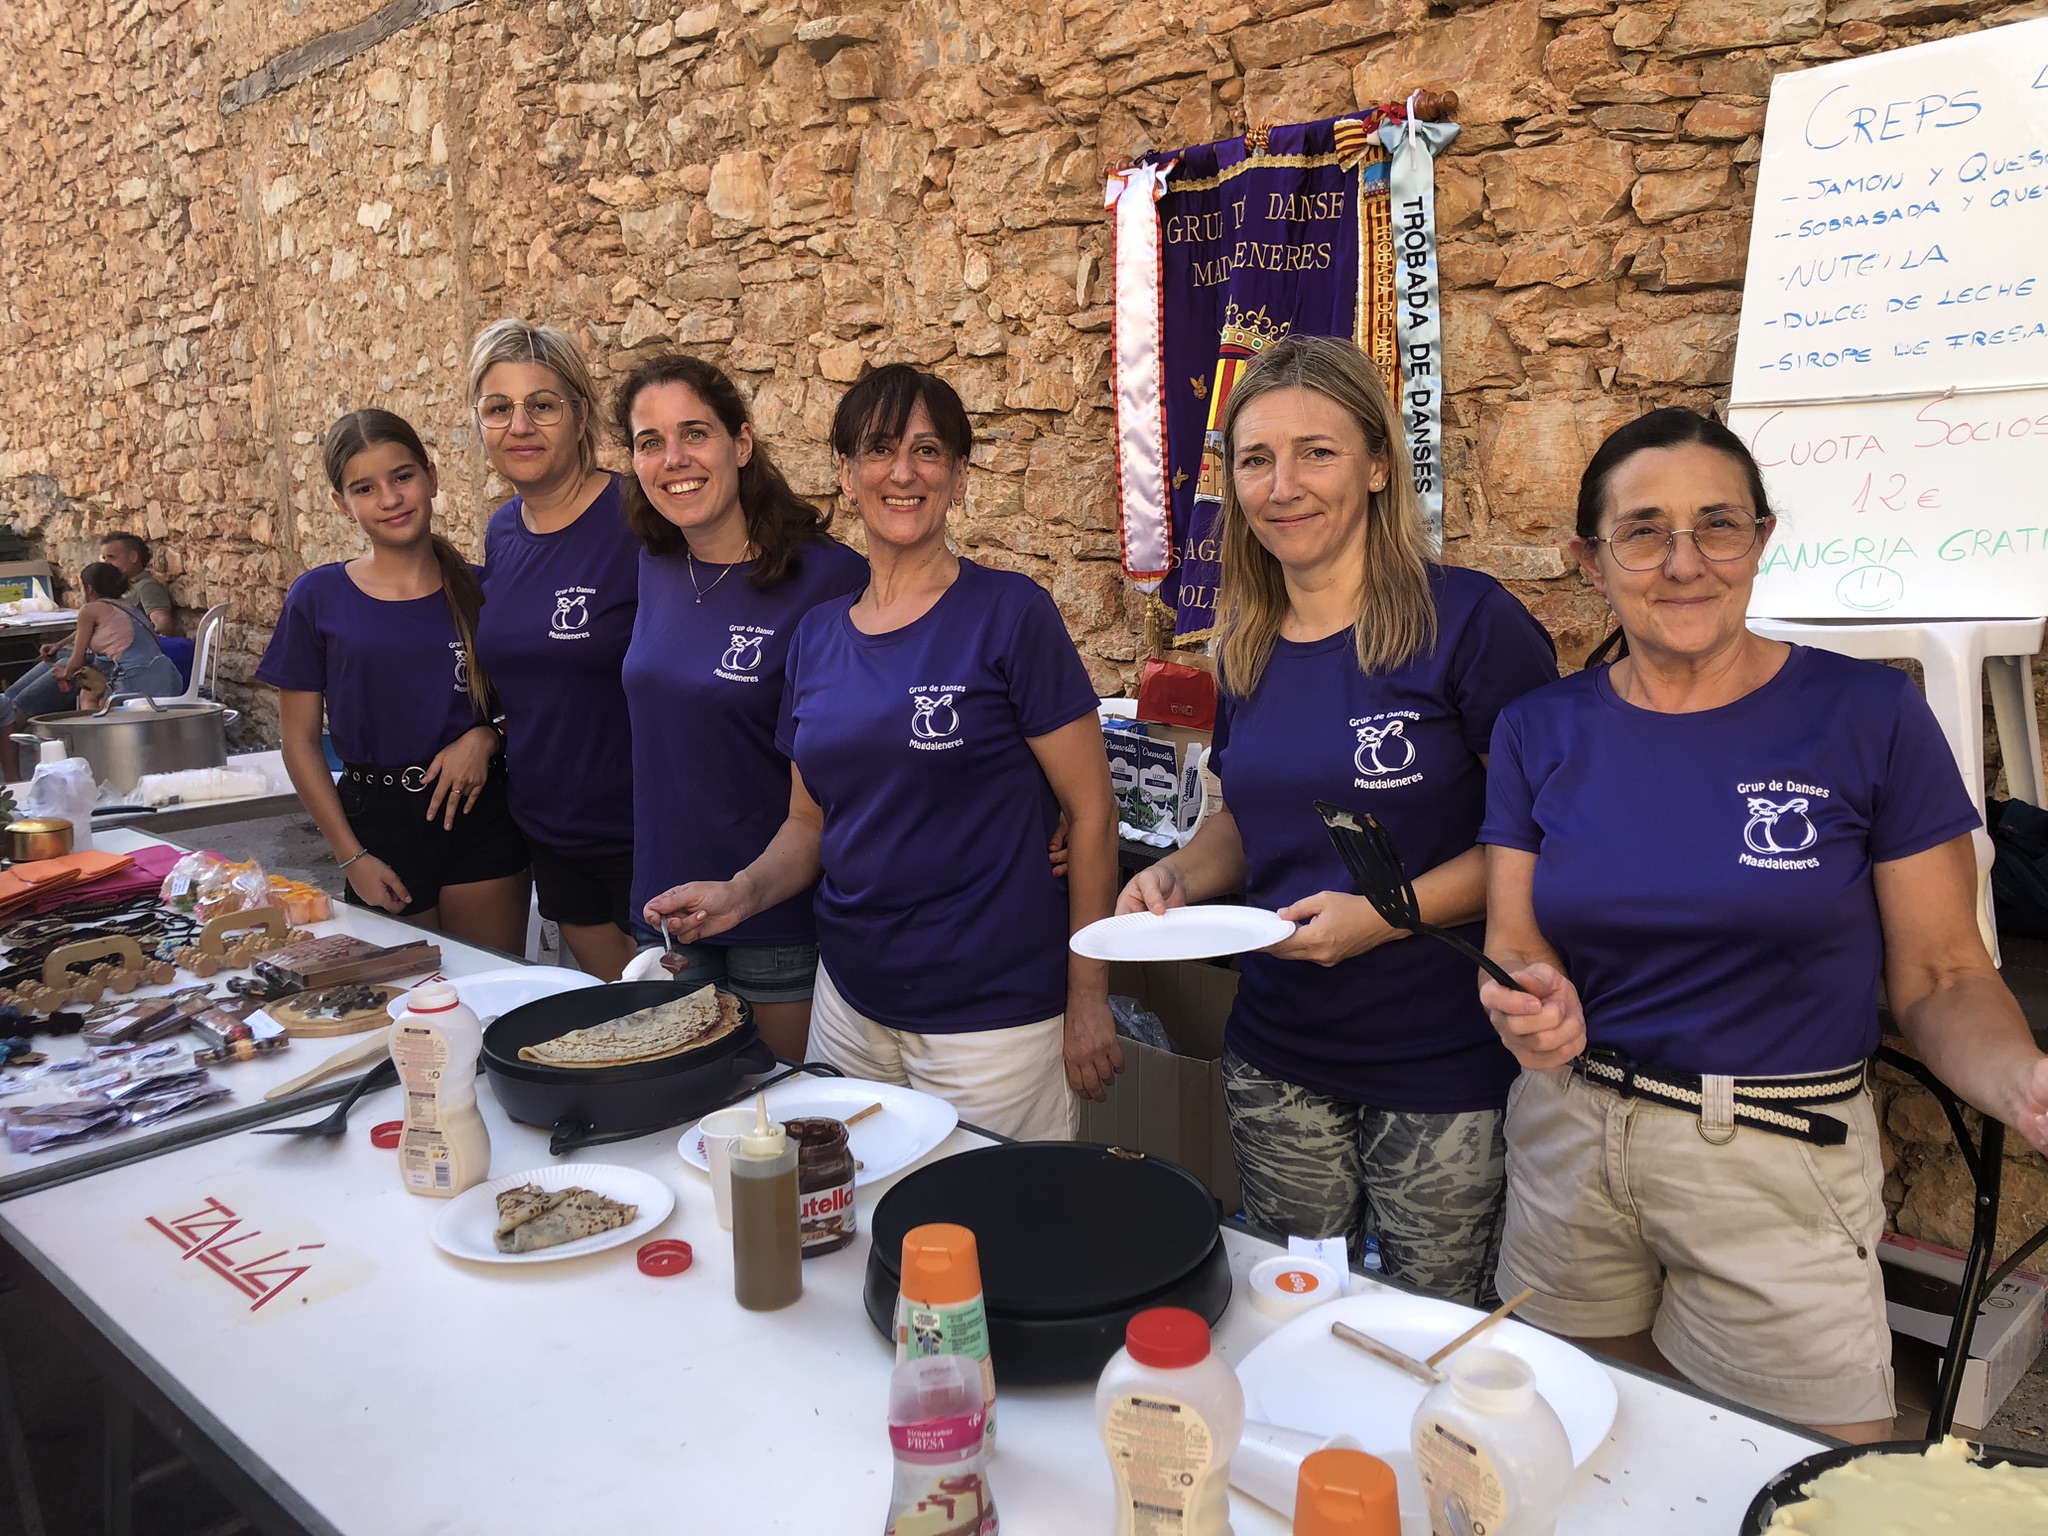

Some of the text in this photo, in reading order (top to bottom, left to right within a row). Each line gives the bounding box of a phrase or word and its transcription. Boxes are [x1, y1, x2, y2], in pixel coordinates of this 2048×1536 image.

[1805, 84, 1982, 149] CREPS
[1928, 168, 1943, 186] Y
[1958, 150, 2048, 183] QUES
[1963, 195, 1974, 212] Y
[1990, 185, 2048, 208] QUE
[1167, 211, 1224, 244] GRU
[1403, 196, 1429, 330] TROBADA
[1887, 295, 1923, 313] DE
[1938, 278, 2036, 306] LECHE
[1377, 302, 1393, 320] DE
[1409, 343, 1430, 377] DE
[1411, 389, 1432, 494] DANSES
[1751, 411, 1885, 467] CUOTA
[909, 684, 966, 694] Grup de Danses
[1349, 710, 1421, 727] Grup de Danses
[909, 738, 964, 750] Magdaleneres
[1354, 772, 1424, 789] Magdaleneres
[1737, 780, 1830, 798] Grup de Danses
[1738, 853, 1820, 870] Magdaleneres
[800, 1187, 854, 1219] utella
[907, 1437, 945, 1450] FRESA
